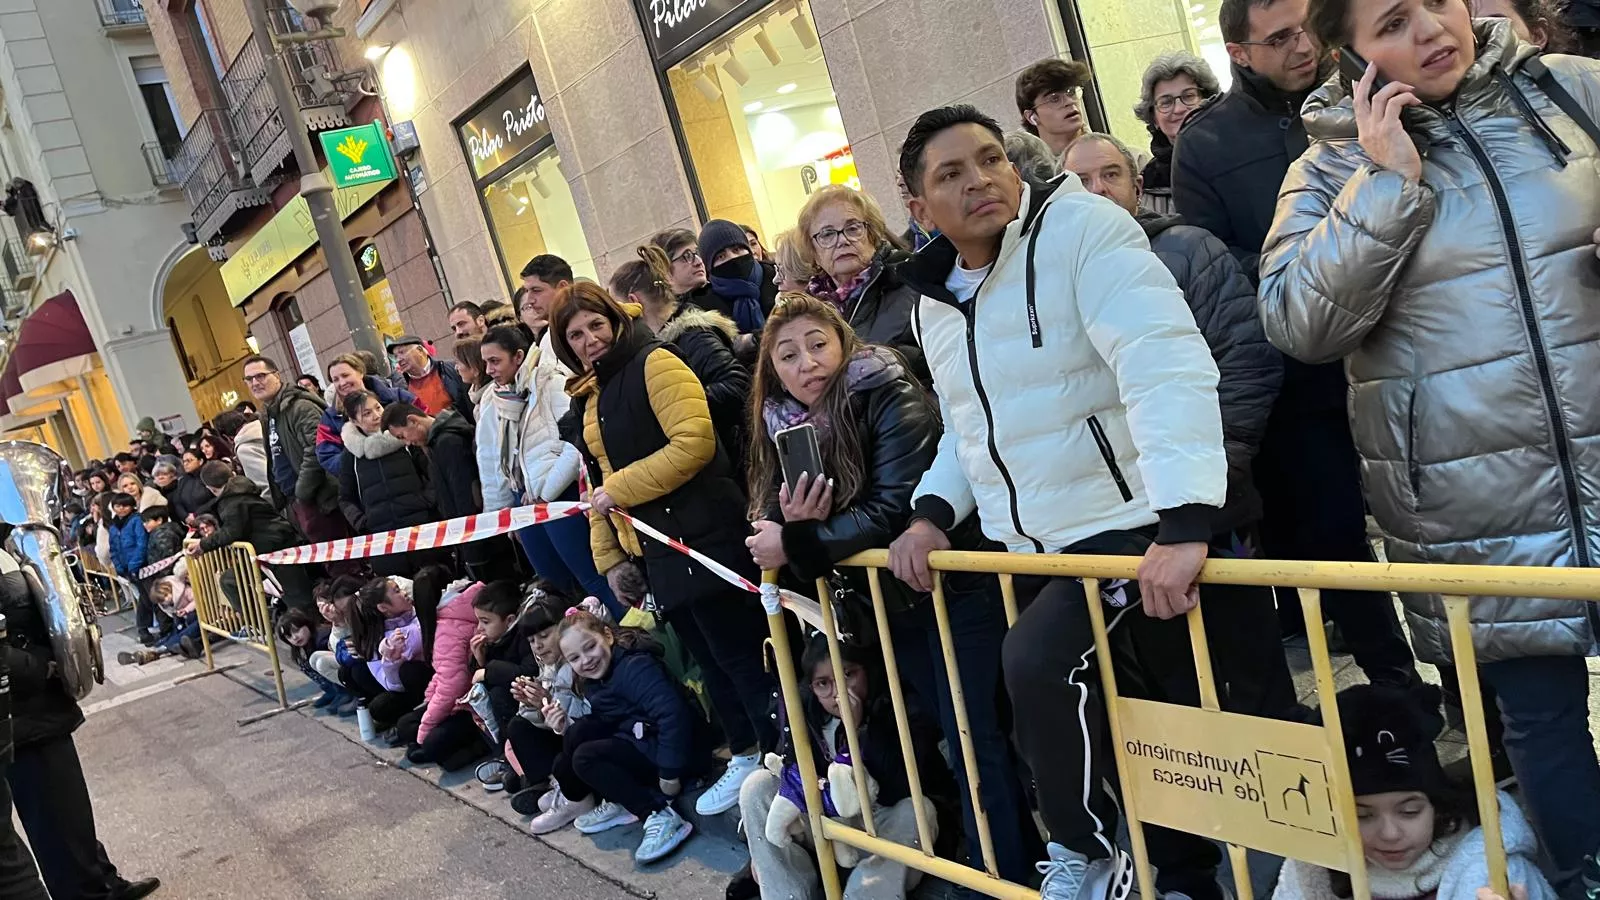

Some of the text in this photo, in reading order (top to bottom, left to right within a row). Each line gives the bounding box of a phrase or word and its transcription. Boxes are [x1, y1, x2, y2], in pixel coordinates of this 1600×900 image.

[468, 94, 545, 168] Pilar Prieto
[348, 165, 372, 174] CAJERO
